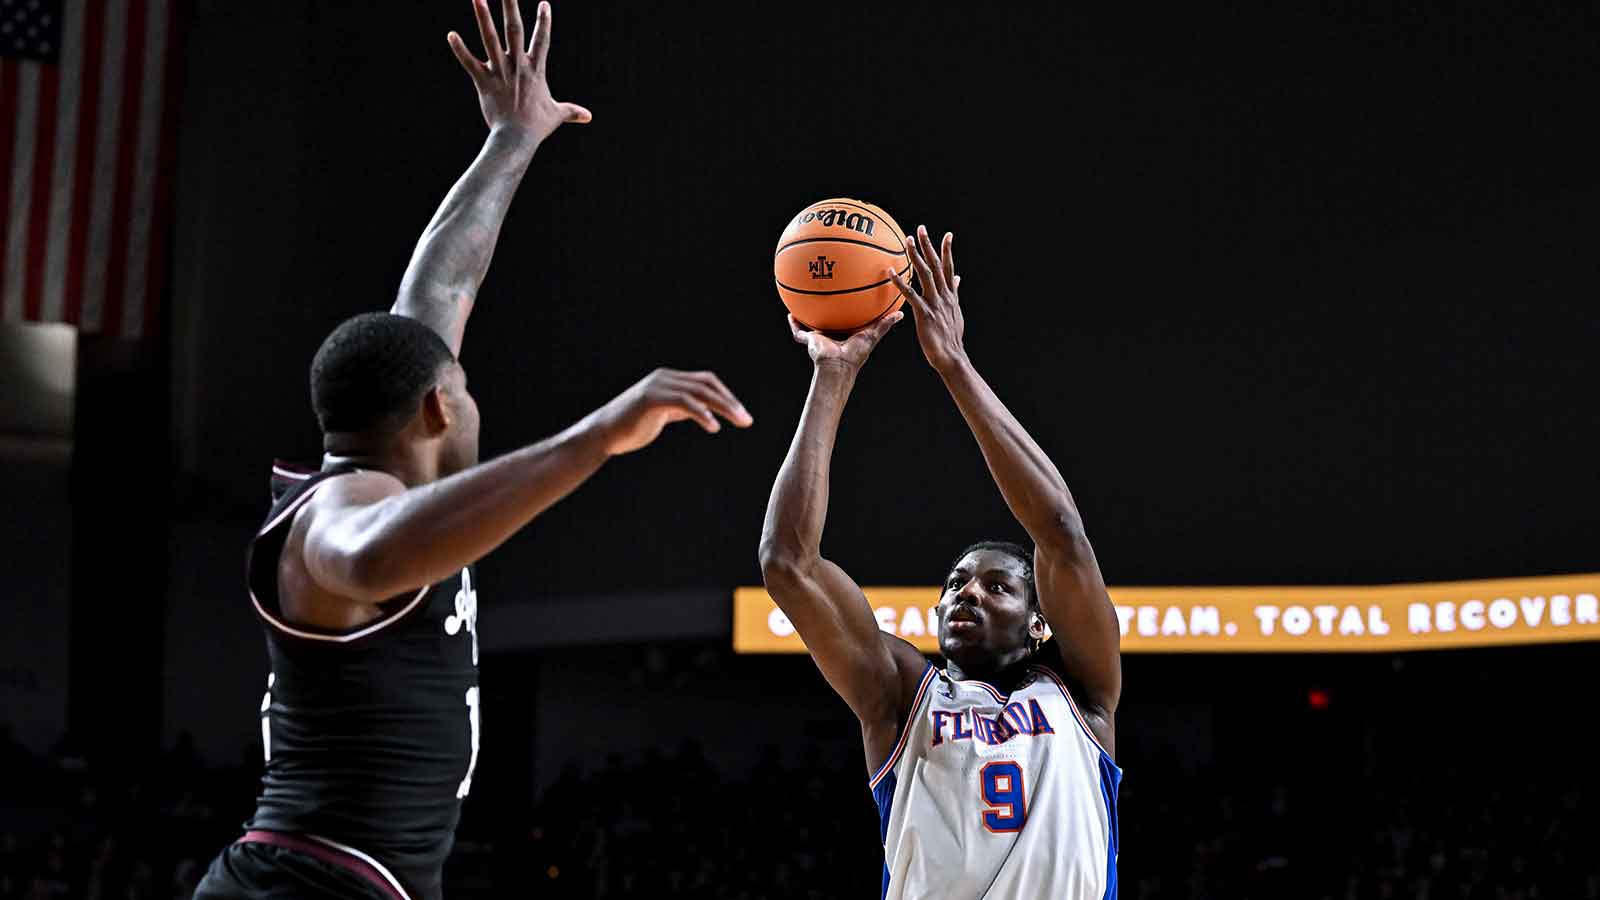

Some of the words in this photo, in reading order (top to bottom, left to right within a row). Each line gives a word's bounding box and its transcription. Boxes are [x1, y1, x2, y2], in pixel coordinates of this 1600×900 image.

[799, 209, 875, 237] Wilso
[1115, 605, 1238, 637] TEAM.
[1254, 604, 1390, 636] TOTAL
[931, 698, 1056, 747] FLORIDA
[979, 760, 1028, 833] 9
